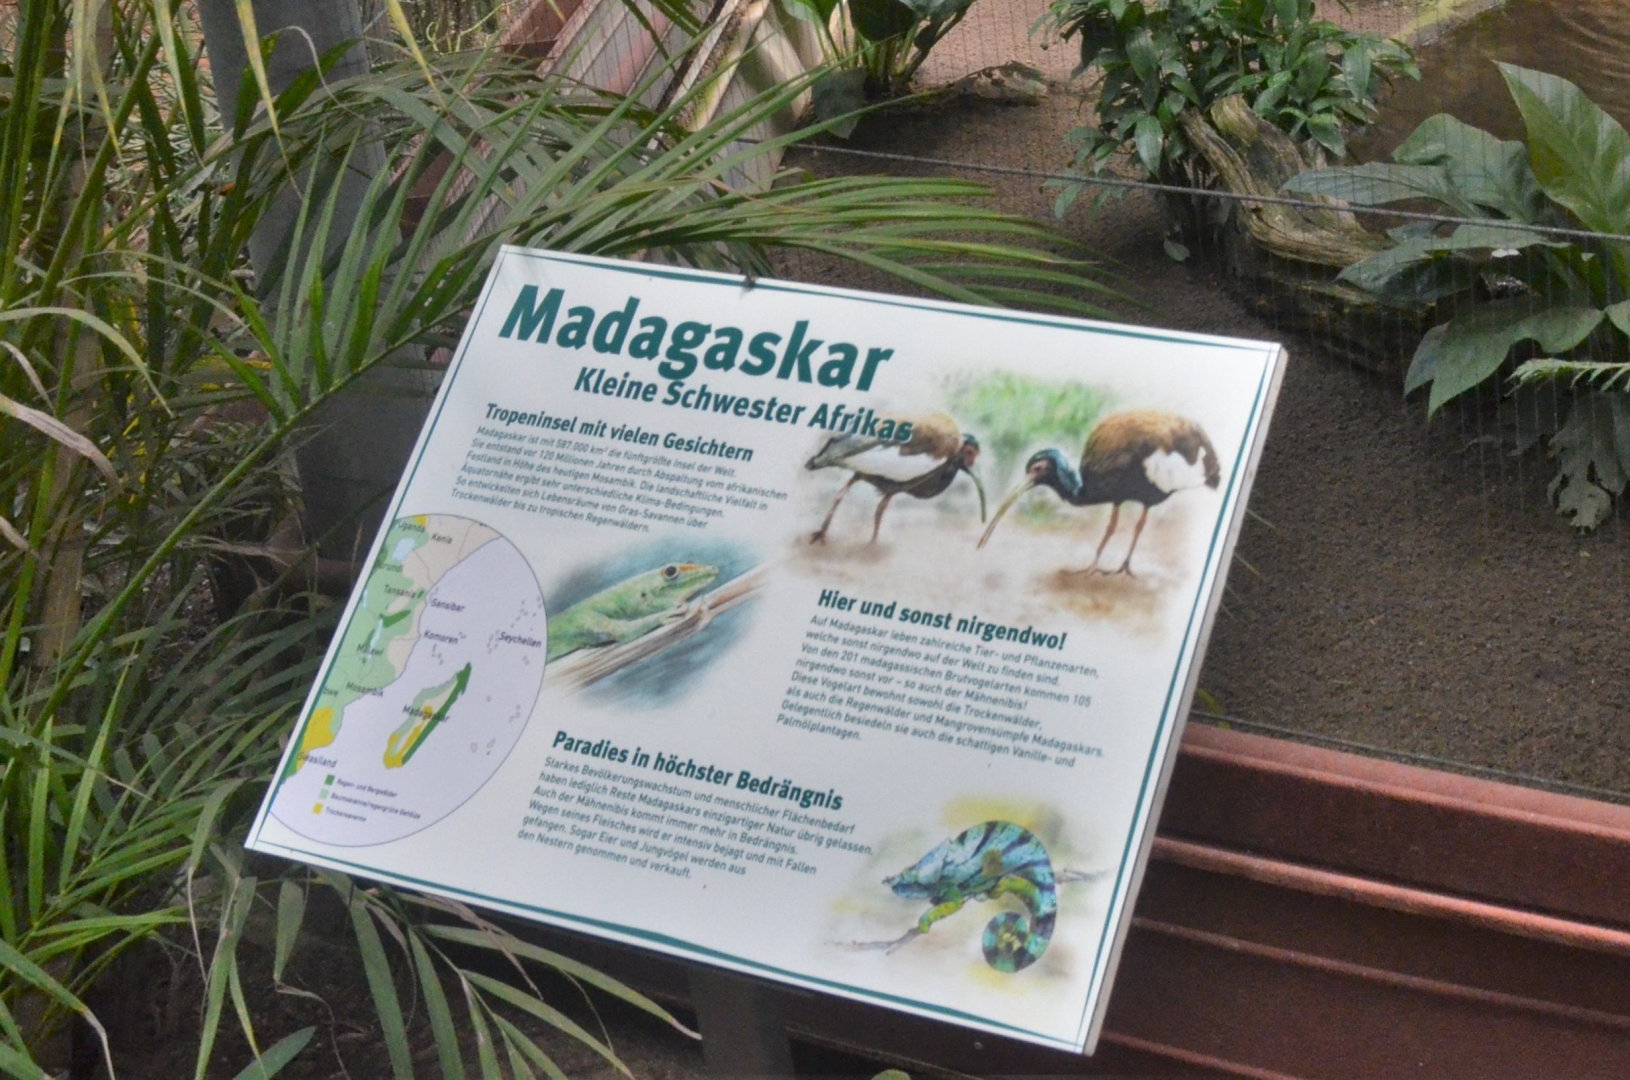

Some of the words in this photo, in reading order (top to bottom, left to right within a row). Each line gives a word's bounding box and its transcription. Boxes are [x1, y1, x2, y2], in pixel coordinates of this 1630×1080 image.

[499, 285, 895, 392] Madagaskar
[485, 402, 578, 433] Tropeninsel
[578, 419, 608, 438] mit
[610, 423, 660, 447] vielen
[662, 431, 754, 462] Gesichtern
[573, 367, 658, 403] Kleine
[661, 380, 805, 426] Schwester
[807, 401, 914, 444] Afrikas
[471, 437, 486, 449] Sie
[485, 442, 524, 456] entstand
[523, 448, 538, 458] vor
[539, 449, 556, 461] 120
[554, 452, 595, 467] Millionen
[595, 460, 627, 473] Jahren
[626, 465, 653, 477] durch
[653, 469, 704, 489] Abspaltung
[705, 480, 725, 489] vom
[725, 482, 788, 500] afrikanischen
[476, 425, 528, 443] Madagaskar
[527, 434, 540, 445] ist
[539, 437, 556, 447] mit
[607, 448, 623, 459] die
[672, 459, 697, 471] Insel
[696, 463, 713, 474] der
[465, 450, 504, 466] Festland
[502, 456, 512, 467] in
[512, 459, 536, 471] Höhe
[535, 463, 552, 474] des
[552, 465, 591, 481] heutigen
[639, 480, 655, 492] Die
[655, 483, 724, 504] landschaftliche
[725, 495, 758, 510] Vielfalt
[757, 502, 769, 511] in
[514, 474, 541, 486] ergibt
[540, 478, 562, 489] sehr
[562, 483, 635, 502] unterschiedliche
[430, 598, 466, 613] Sansibar
[817, 588, 858, 612] Hier
[859, 600, 898, 620] und
[898, 607, 953, 631] sonst
[955, 615, 1068, 651] nirgendwo!
[424, 629, 459, 645] Komoren
[498, 631, 542, 648] Seychellen
[805, 631, 840, 645] welche
[841, 637, 869, 649] sonst
[869, 642, 923, 660] nirgendwo
[922, 653, 942, 664] auf
[941, 655, 961, 667] der
[962, 658, 985, 672] Welt
[985, 664, 1000, 675] zu
[1000, 664, 1035, 681] finden
[809, 614, 829, 627] Auf
[828, 618, 889, 638] Madagaskar
[890, 630, 919, 644] leben
[919, 636, 973, 654] zahlreiche
[975, 644, 999, 658] Tier-
[1001, 652, 1023, 664] und
[791, 670, 819, 686] Diese
[820, 676, 862, 694] Vogelart
[862, 685, 907, 703] bewohnt
[907, 695, 944, 711] sowohl
[945, 702, 962, 714] die
[795, 658, 848, 676] nirgendwo
[848, 668, 877, 682] sonst
[877, 674, 895, 685] vor
[903, 679, 917, 690] so
[917, 682, 943, 695] auch
[943, 686, 963, 698] der
[801, 642, 819, 655] Von
[819, 646, 840, 659] den
[840, 649, 859, 663] 201
[860, 655, 943, 679] madagassischen
[944, 669, 1022, 694] Brutvogelarten
[1023, 685, 1070, 703] kommen
[1073, 694, 1093, 708] 105
[781, 698, 843, 721] Gelegentlich
[843, 712, 893, 731] besiedeln
[894, 723, 910, 735] sie
[910, 727, 937, 740] auch
[937, 731, 955, 744] die
[955, 736, 1010, 755] schattigen
[1012, 745, 1052, 763] Vanille-
[1054, 756, 1077, 768] und
[785, 686, 801, 698] als
[802, 690, 827, 702] auch
[827, 694, 844, 706] die
[845, 696, 912, 719] Regenwälder
[912, 713, 934, 724] und
[934, 714, 1030, 744] Mangrovensümpfe
[544, 756, 580, 774] Starkes
[580, 763, 693, 798] Bevölkerungswachstum
[693, 792, 714, 804] und
[713, 796, 781, 818] menschlicher
[781, 808, 856, 835] Flächenbedarf
[552, 730, 630, 764] Paradies
[631, 746, 651, 769] in
[652, 751, 734, 786] höchster
[735, 770, 844, 811] Bedrängnis
[529, 799, 560, 816] Wegen
[560, 808, 592, 823] seines
[592, 813, 637, 834] Fleisches
[638, 827, 661, 840] wird
[660, 832, 673, 841] er
[673, 833, 713, 851] intensiv
[712, 841, 745, 861] bejagt
[745, 851, 766, 864] und
[766, 856, 784, 868] mit
[785, 857, 817, 875] Fallen
[532, 785, 558, 799] Auch
[557, 791, 576, 803] der
[575, 794, 630, 817] Mähnenibis
[630, 807, 665, 824] kommt
[665, 815, 699, 831] immer
[699, 824, 727, 838] mehr
[727, 829, 738, 841] in
[539, 770, 568, 786] haben
[568, 777, 609, 795] lediglich
[608, 786, 637, 803] Reste
[637, 792, 701, 817] Madagaskars
[702, 809, 766, 832] einzigartiger
[766, 821, 796, 838] Natur
[797, 829, 825, 848] übrig
[516, 828, 536, 841] den
[535, 832, 575, 851] Nestern
[574, 843, 629, 863] genommen
[629, 857, 649, 869] und
[569, 823, 599, 841] Sogar
[598, 830, 619, 845] Eier
[619, 838, 640, 851] und
[638, 841, 690, 863] Jungvögel
[690, 855, 727, 871] werden
[727, 863, 747, 876] aus
